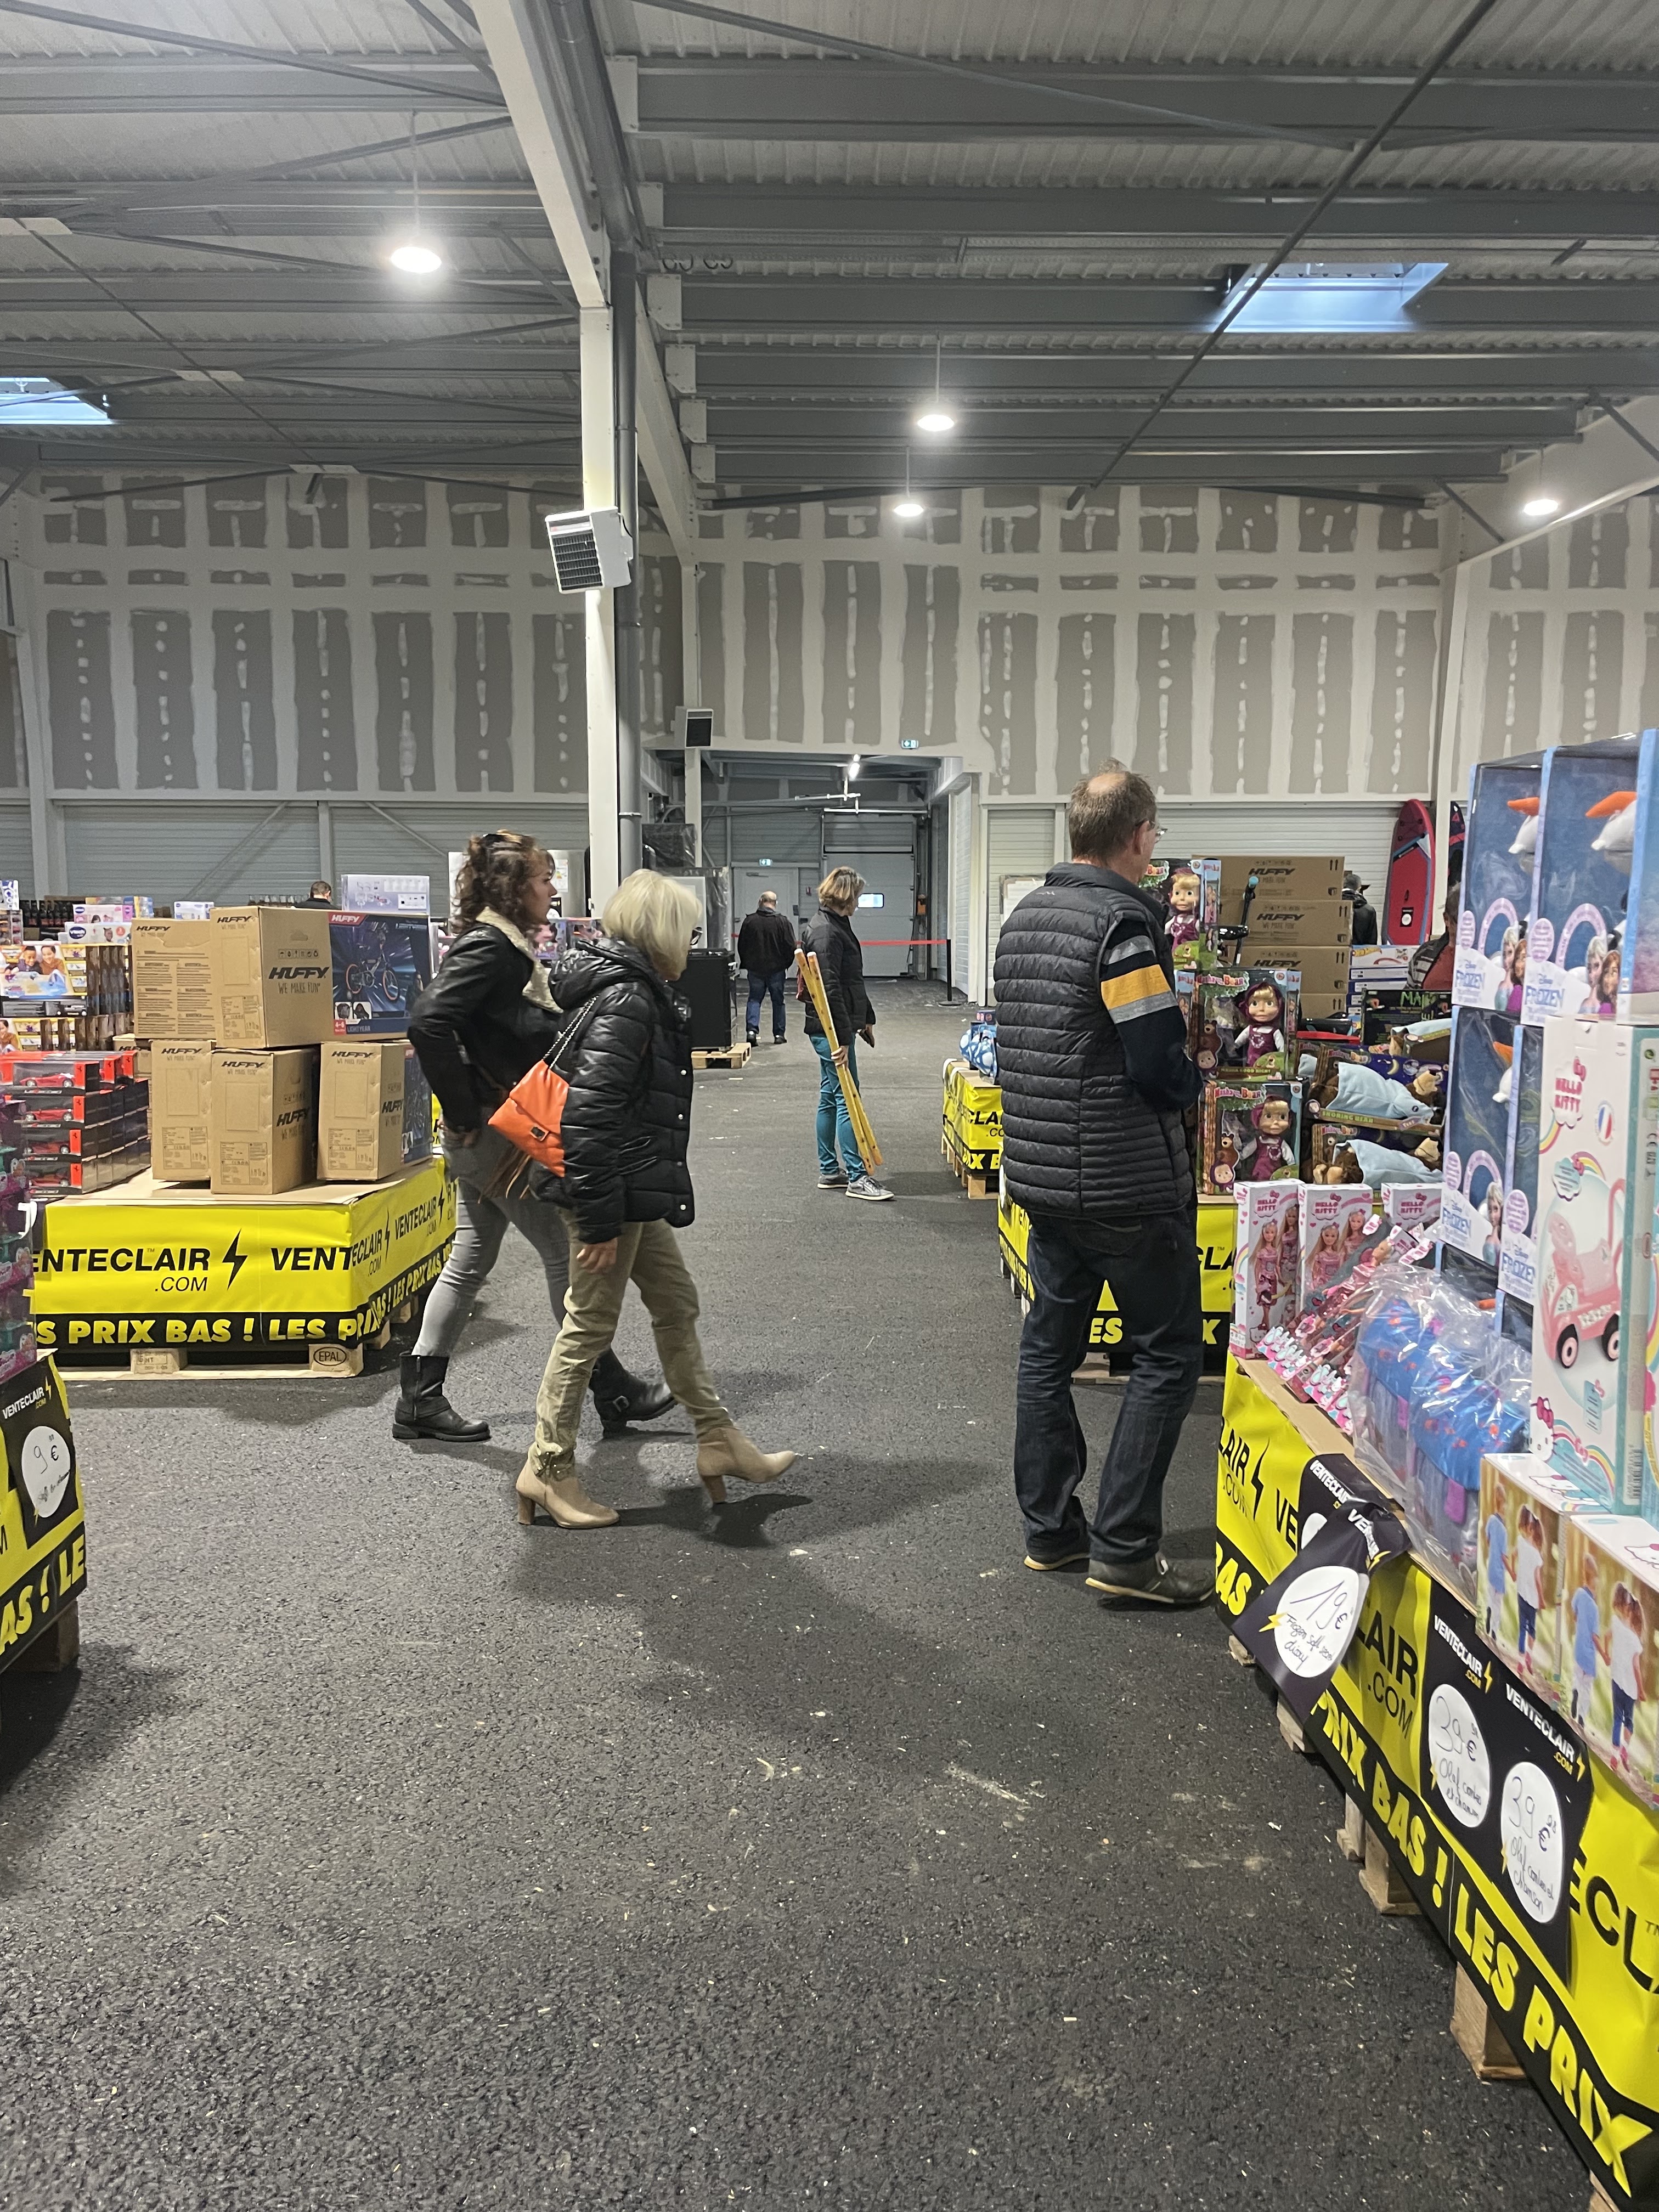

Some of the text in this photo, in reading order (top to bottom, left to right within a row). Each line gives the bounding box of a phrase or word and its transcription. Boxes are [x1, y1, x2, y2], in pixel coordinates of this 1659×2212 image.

[269, 967, 330, 979] HUFFY
[278, 983, 287, 994] WE
[290, 983, 306, 994] MAKE
[1555, 1077, 1582, 1094] HELLO
[1554, 1094, 1581, 1113] KITTY
[276, 1107, 310, 1127] HUFFY
[395, 1197, 437, 1240] VENTECLAIR
[155, 1277, 208, 1291] .COM
[69, 1320, 156, 1344] PRIX
[166, 1319, 232, 1343] BAS
[243, 1318, 254, 1341] !
[269, 1319, 326, 1341] LES
[319, 1350, 341, 1362] EPAL
[3, 1386, 44, 1419] VENTECLAIR
[51, 1444, 59, 1461] €
[40, 1565, 50, 1613] !
[1290, 1580, 1348, 1629] 19 €
[1434, 1615, 1483, 1678] VENTECLAIR
[1465, 1669, 1482, 1690] .COM
[1368, 1671, 1413, 1739] .COM
[1435, 1696, 1465, 1755] 39
[1466, 1740, 1477, 1762] €
[1505, 1683, 1575, 1763] VENTECLAIR
[1553, 1752, 1573, 1775] .COM
[1509, 1776, 1535, 1838] 39
[1538, 1827, 1550, 1852] €
[1372, 1759, 1426, 1876] BAS
[1432, 1846, 1448, 1908] !
[1454, 1883, 1520, 2012] LES
[1523, 1985, 1653, 2198] PRIX
